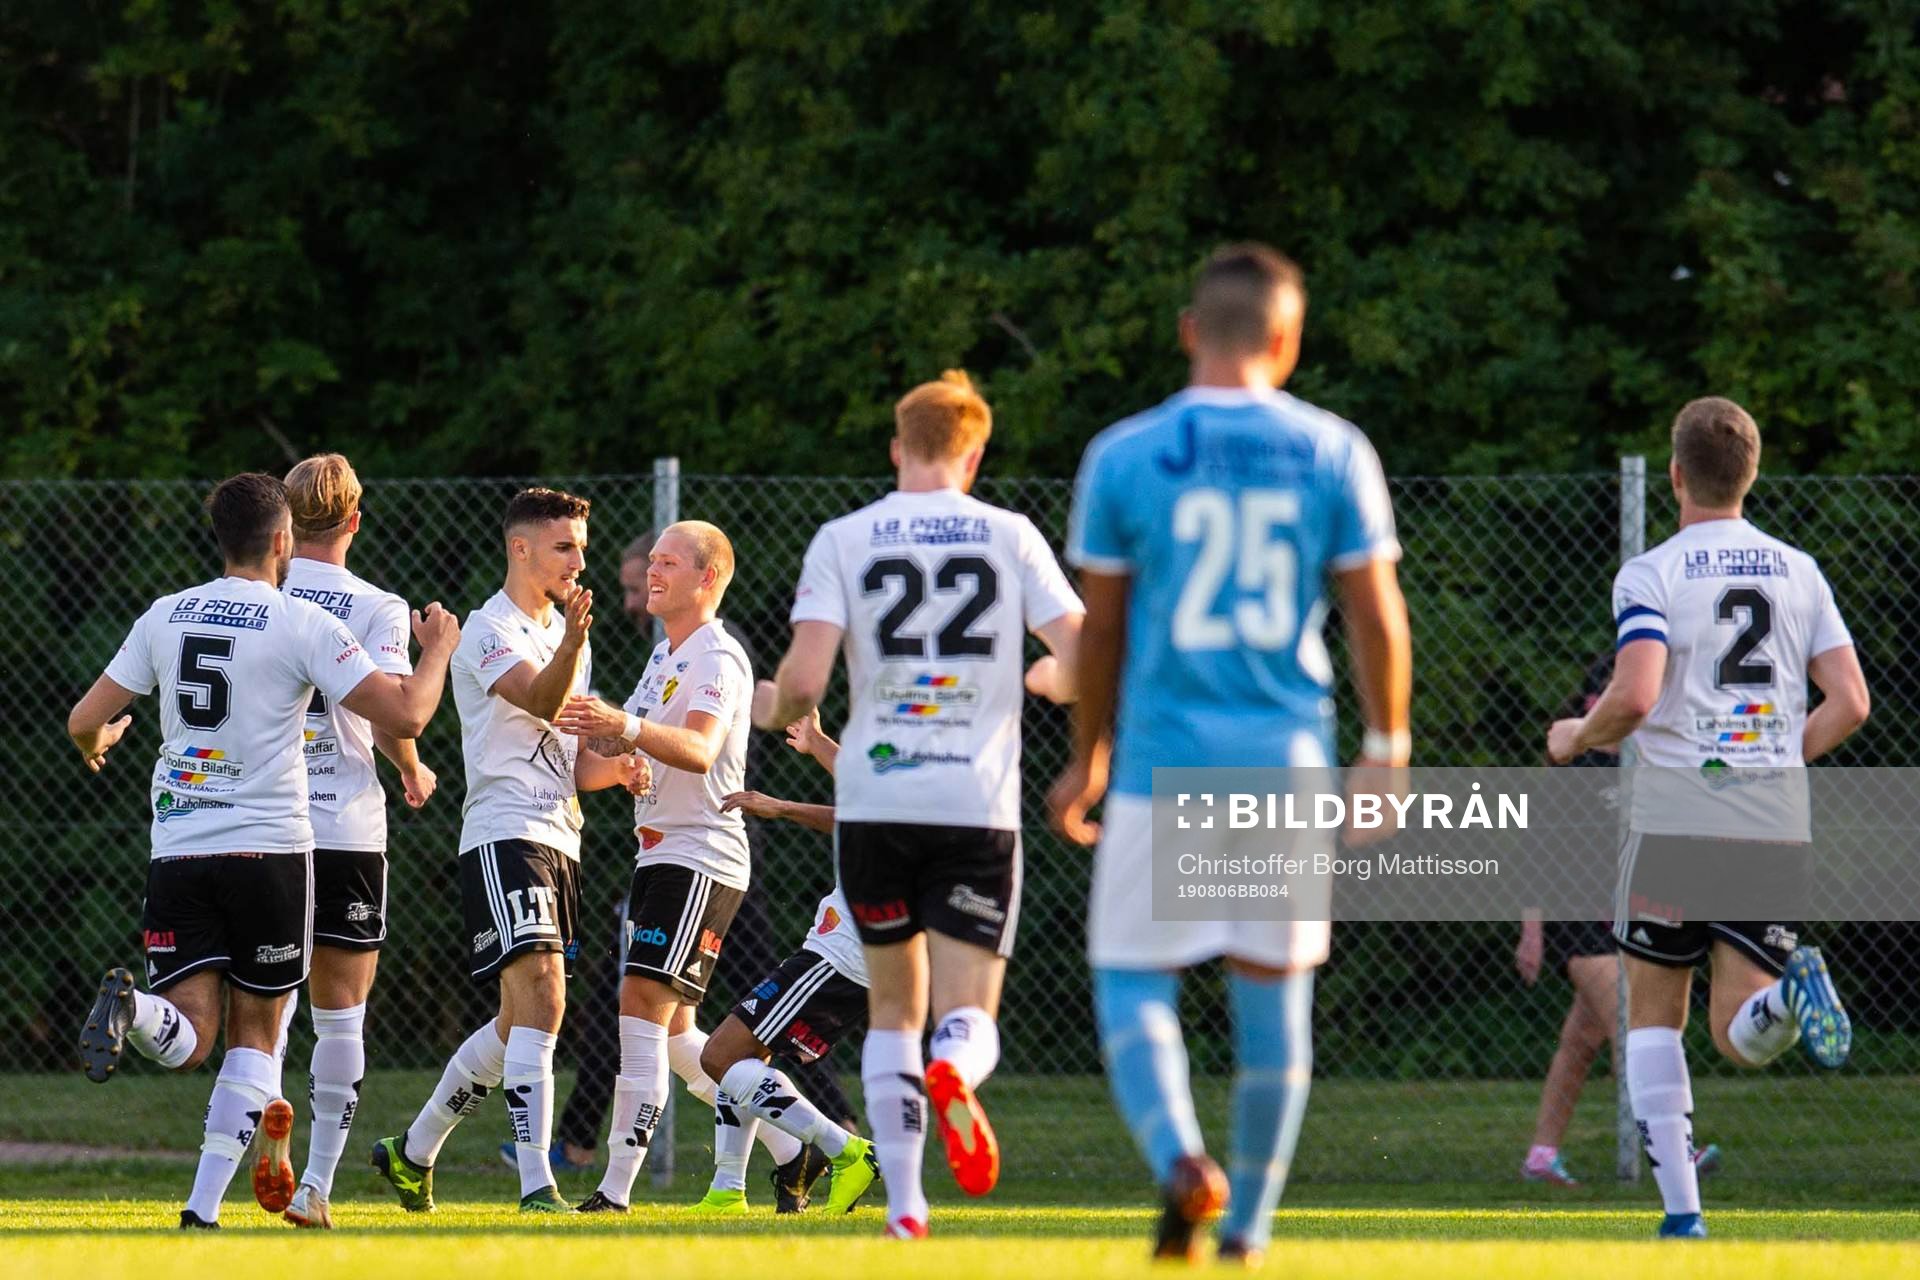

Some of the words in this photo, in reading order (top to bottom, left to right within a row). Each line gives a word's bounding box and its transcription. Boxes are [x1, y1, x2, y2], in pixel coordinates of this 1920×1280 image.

[1172, 487, 1299, 651] 25
[1717, 548, 1787, 566] PROFIL
[174, 598, 200, 611] LB
[200, 599, 269, 619] PROFIL
[860, 554, 1001, 662] 22
[1713, 584, 1776, 690] 2
[176, 632, 236, 732] 5
[201, 761, 242, 777] Bilaffär
[506, 886, 553, 931] LT
[514, 1110, 532, 1143] INTER
